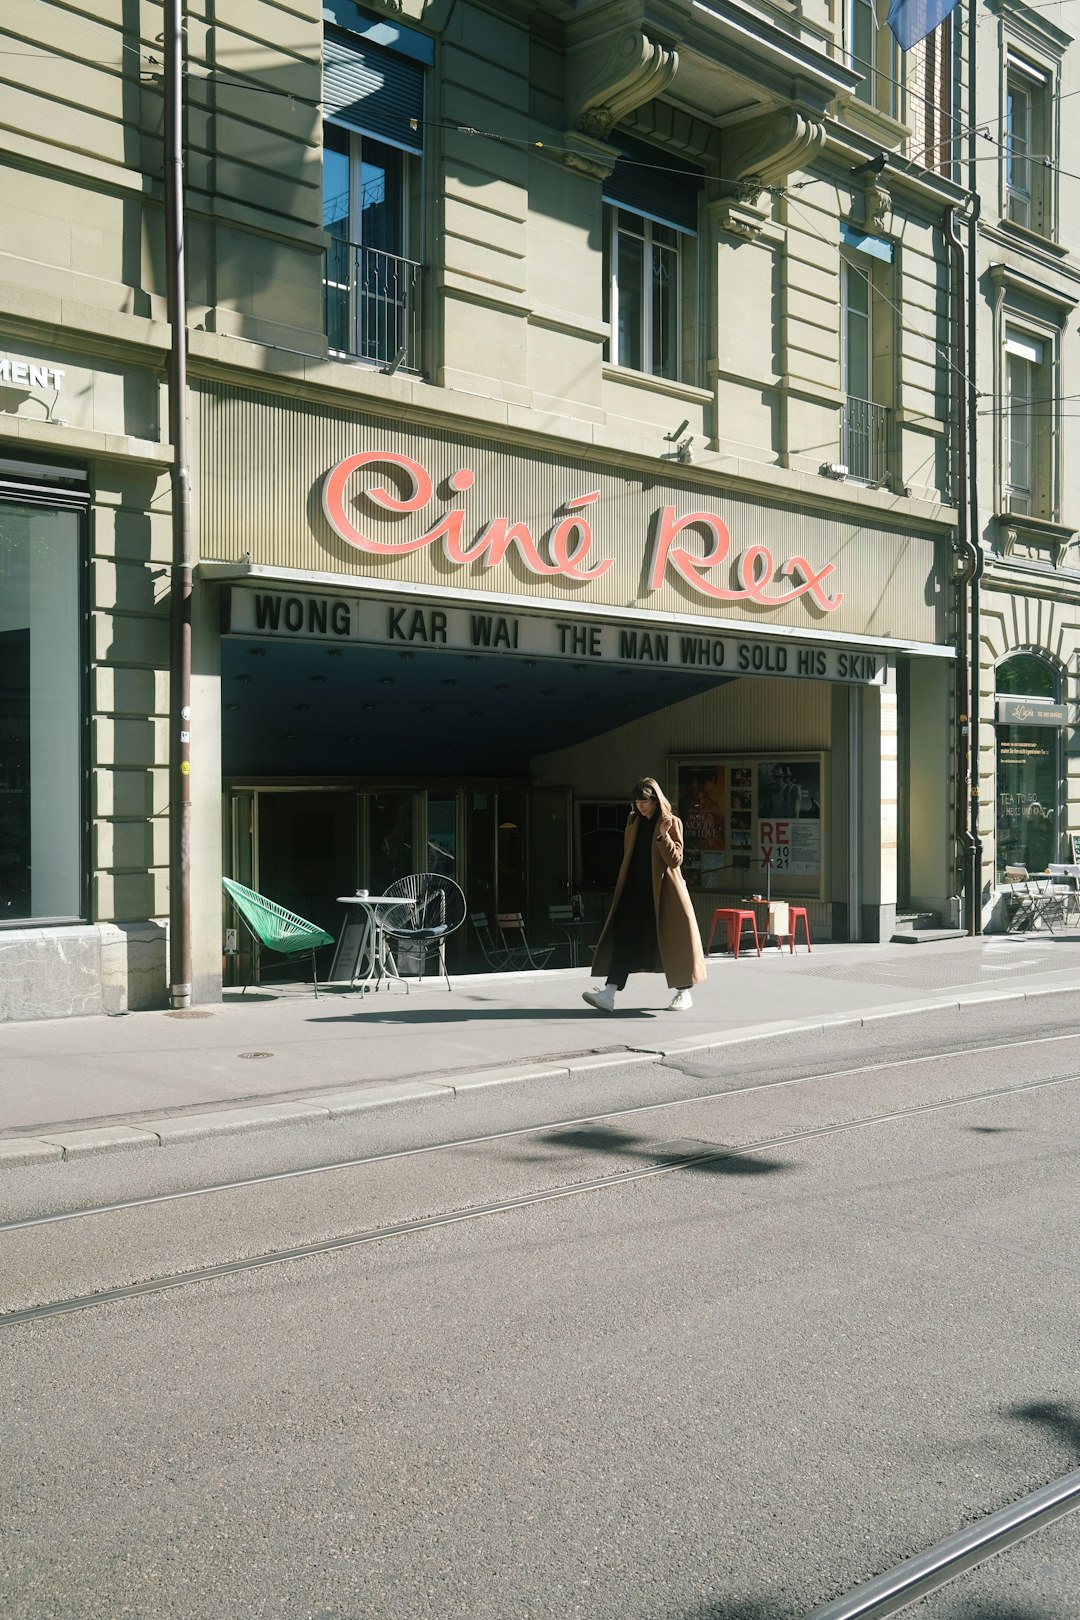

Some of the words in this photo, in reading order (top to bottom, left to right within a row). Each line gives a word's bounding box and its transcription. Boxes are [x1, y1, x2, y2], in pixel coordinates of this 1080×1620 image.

[322, 451, 616, 581] Ciné
[648, 505, 844, 612] Rex
[255, 594, 351, 636] WONG
[389, 607, 447, 643] KAR
[471, 612, 519, 649] WAI
[556, 624, 602, 657] THE
[619, 630, 669, 662] MAN
[681, 637, 725, 667] WHO
[738, 643, 788, 673] SOLD
[799, 650, 827, 676] HIS
[838, 652, 877, 680] SKIN
[1000, 793, 1014, 805] TEA
[1016, 793, 1026, 804] TO
[1028, 793, 1038, 802] GO
[776, 846, 790, 857] 10
[776, 858, 790, 869] 21
